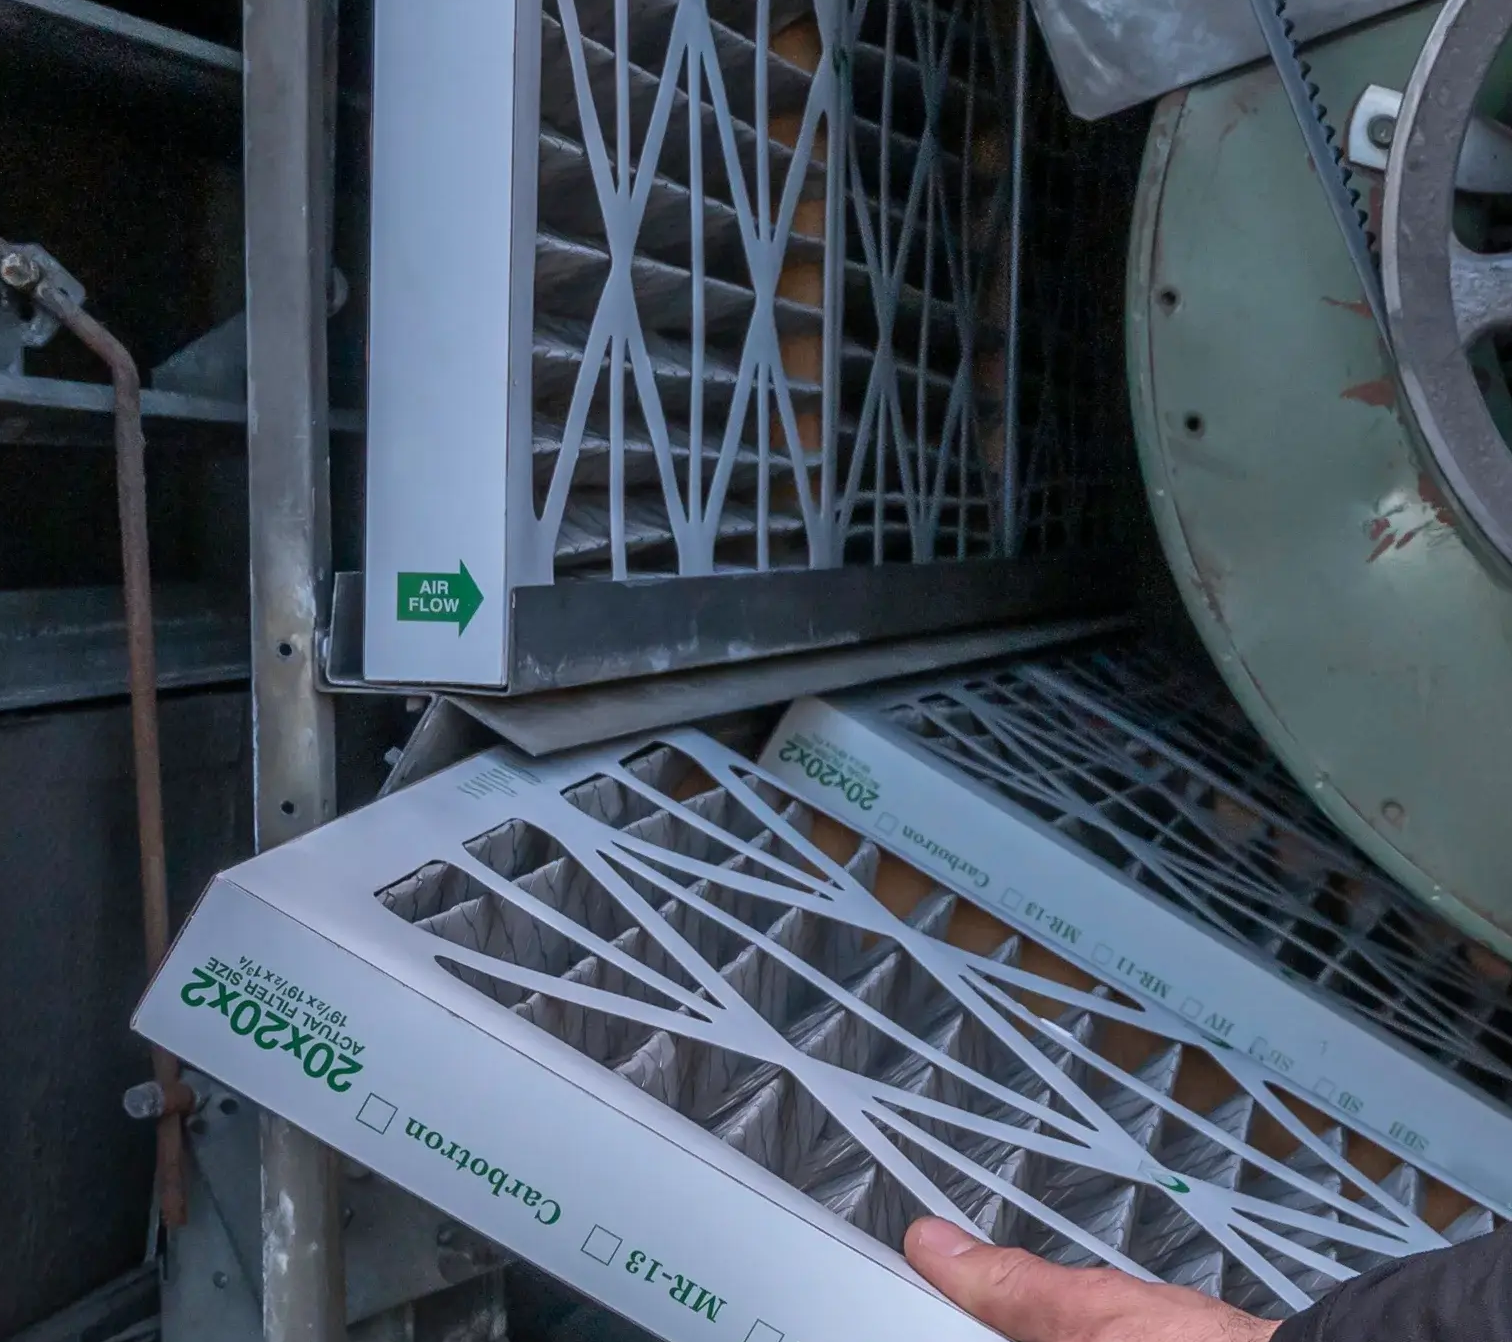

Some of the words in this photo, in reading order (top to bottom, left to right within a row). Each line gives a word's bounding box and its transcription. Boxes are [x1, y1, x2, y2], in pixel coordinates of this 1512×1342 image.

[408, 597, 460, 613] FLOW
[419, 579, 449, 595] AIR
[778, 739, 879, 810] 20x20x2
[903, 826, 989, 887] Carbotron
[205, 957, 243, 986] SIZE
[244, 979, 298, 1019] FILTER
[181, 968, 363, 1092] 20x20x2
[303, 1012, 365, 1056] ACTUAL
[404, 1115, 563, 1227] Carbotron
[626, 1251, 727, 1323] MR-13
